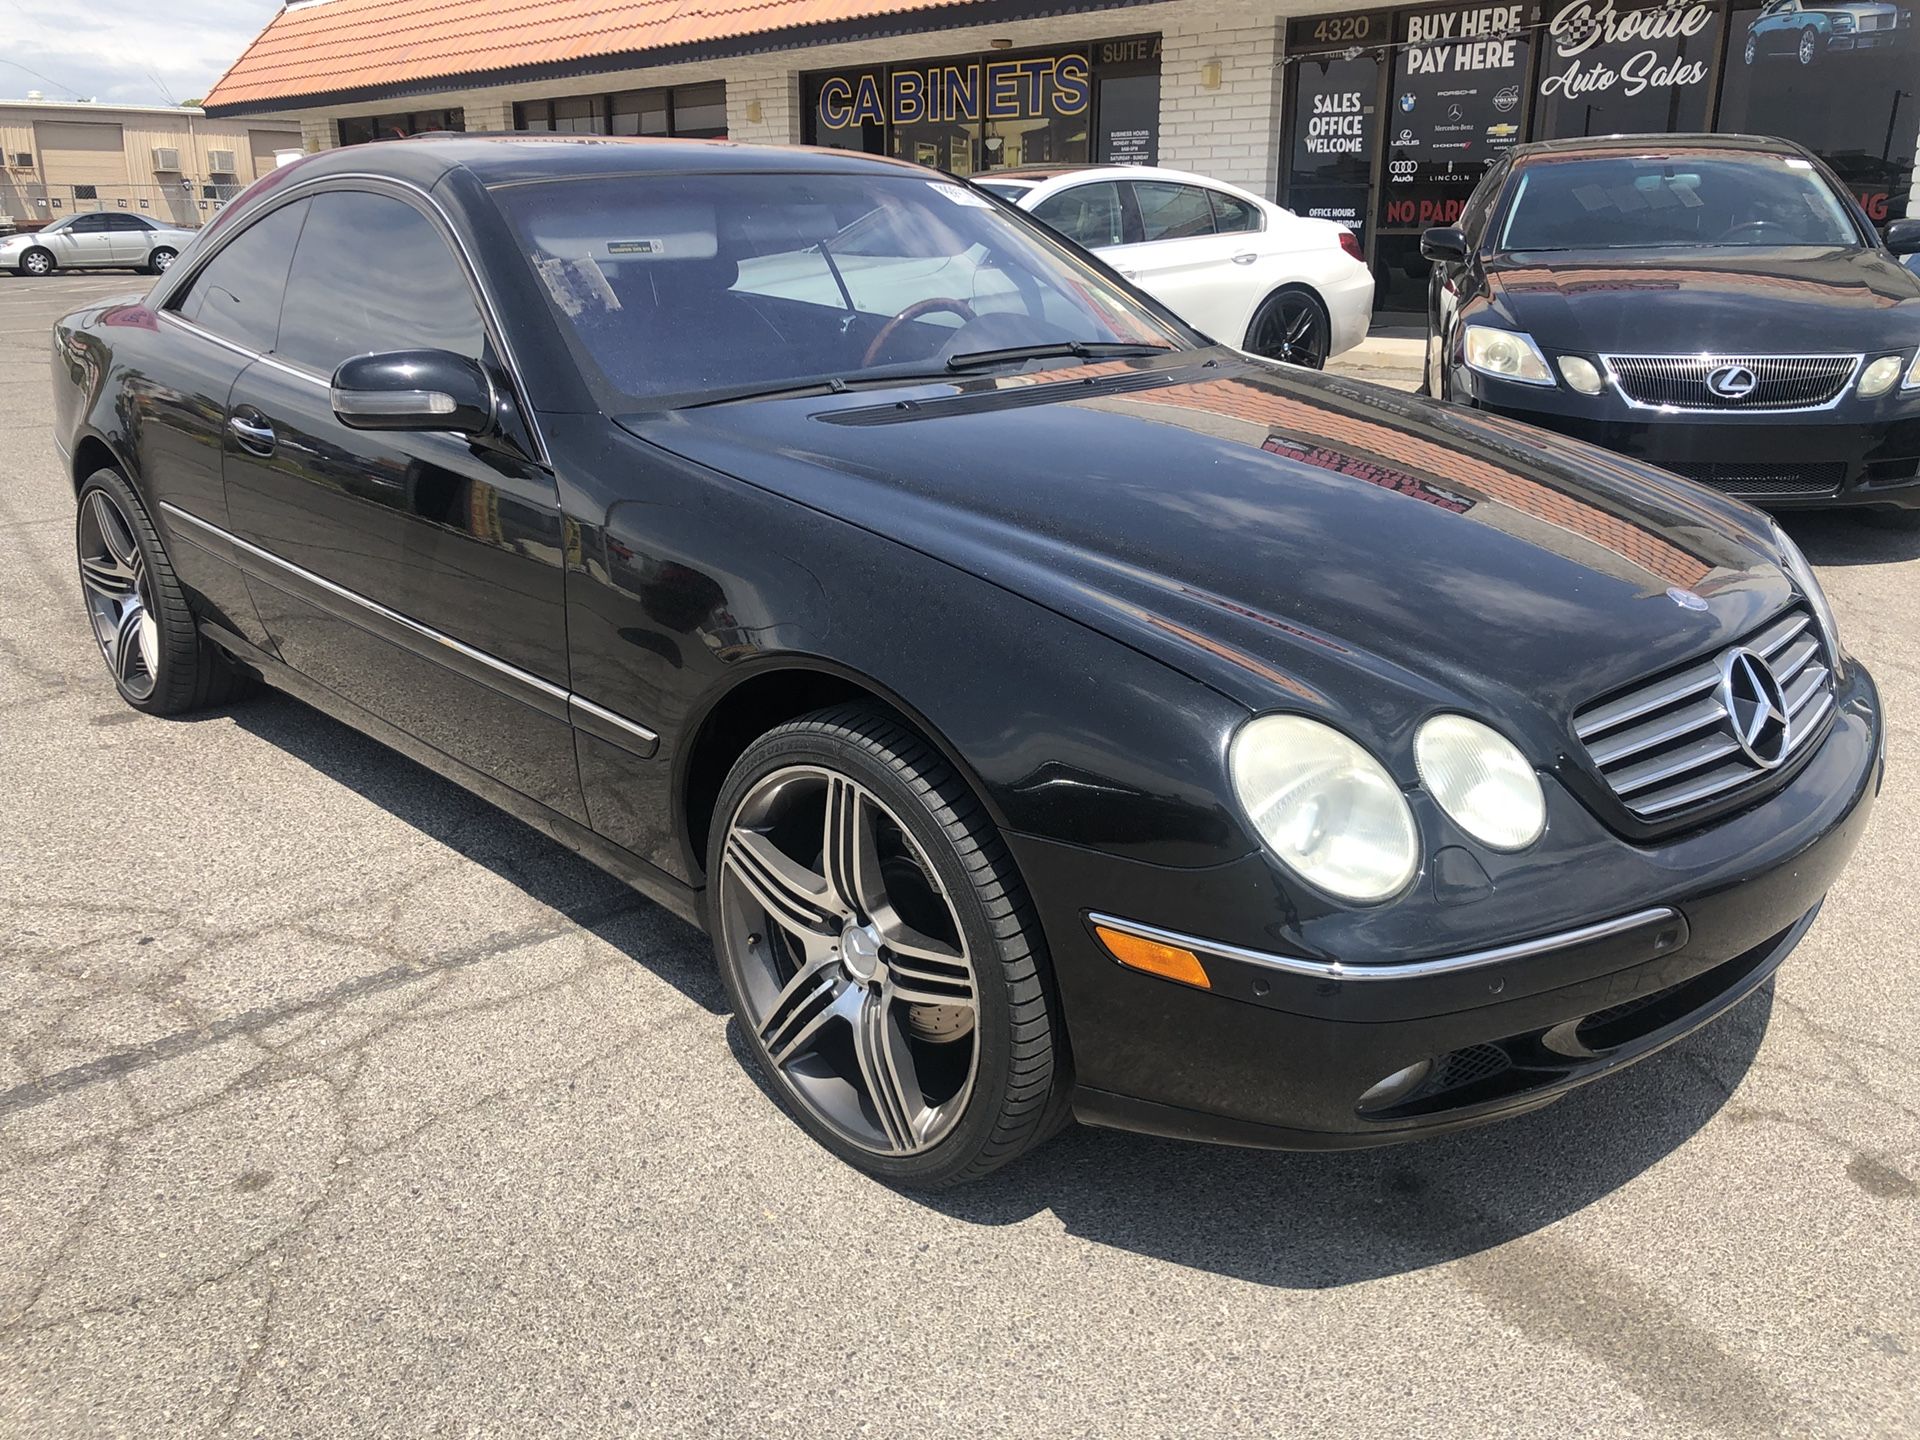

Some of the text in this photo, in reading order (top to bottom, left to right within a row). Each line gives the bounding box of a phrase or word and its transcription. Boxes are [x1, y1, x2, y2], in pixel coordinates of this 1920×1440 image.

[1314, 16, 1370, 42] 4320
[1408, 5, 1523, 44] BUY HERE
[1103, 40, 1147, 63] SUITE
[1407, 39, 1517, 75] PAY HERE
[1540, 50, 1708, 99] Auto Sales
[819, 54, 1088, 130] CABINETS
[1313, 92, 1361, 114] SALES
[1308, 115, 1363, 136] OFFICE
[1306, 137, 1363, 153] WELCOME
[1392, 174, 1414, 182] Audi
[1429, 174, 1470, 182] LINCOLN
[1308, 208, 1356, 217] OFFICE HOURS
[1387, 200, 1416, 223] NO
